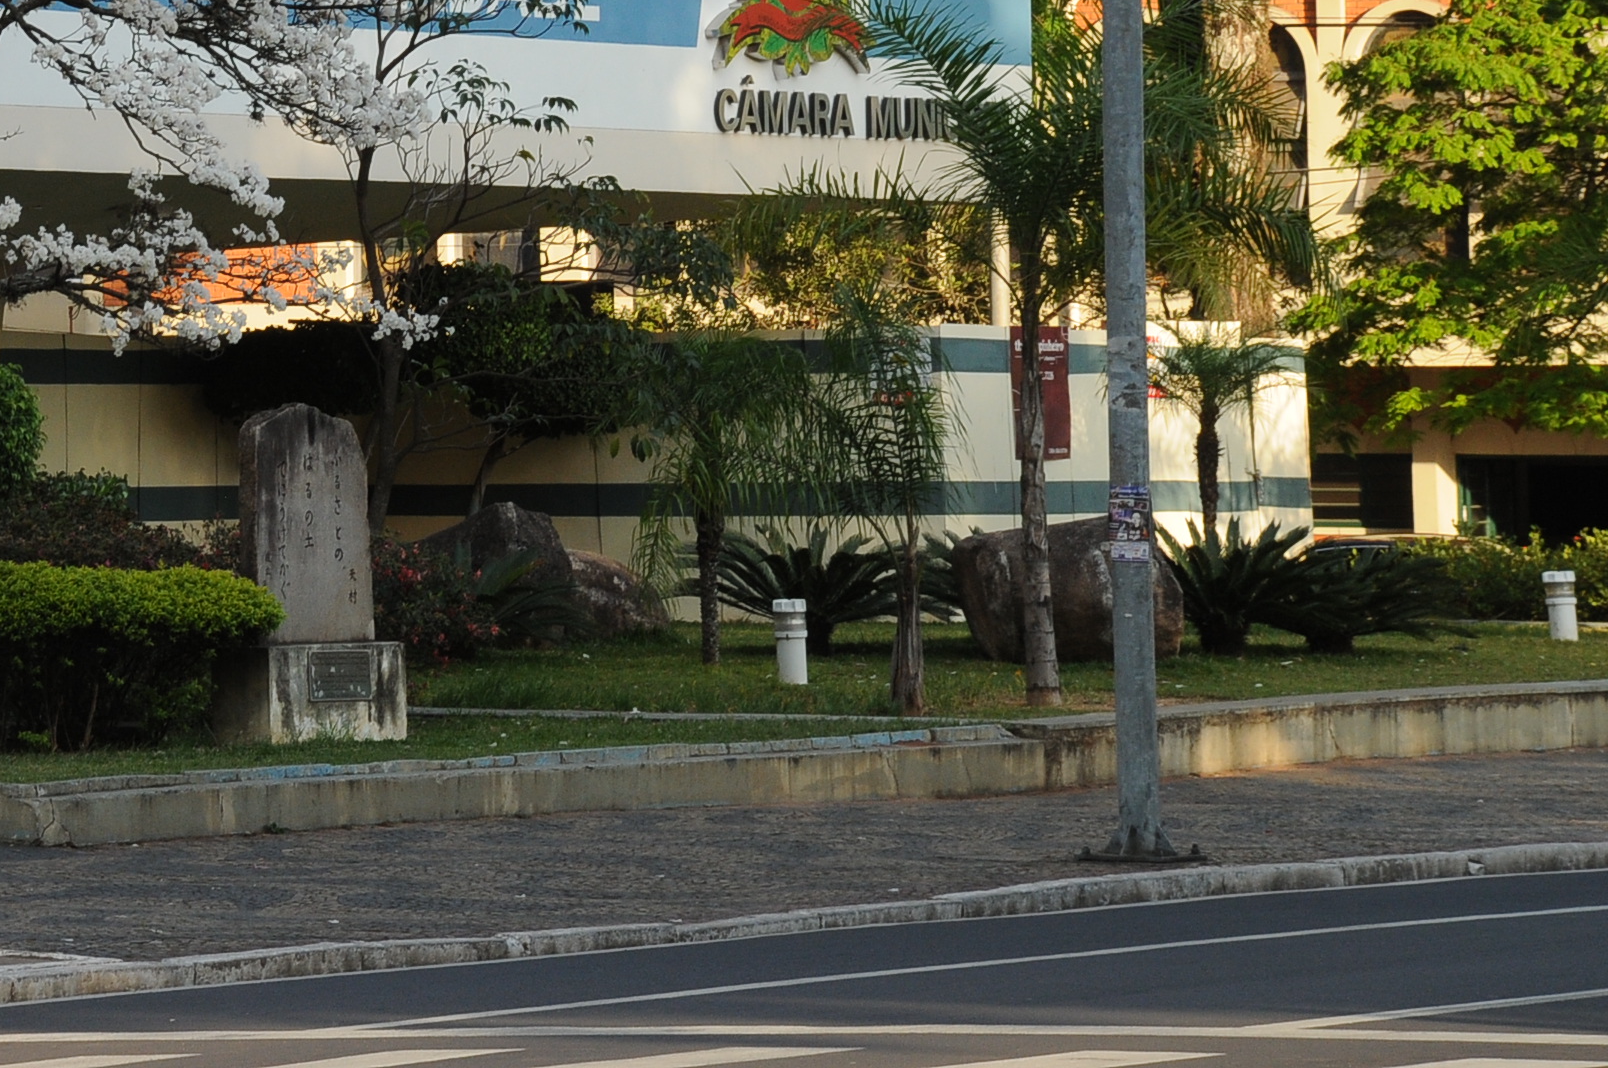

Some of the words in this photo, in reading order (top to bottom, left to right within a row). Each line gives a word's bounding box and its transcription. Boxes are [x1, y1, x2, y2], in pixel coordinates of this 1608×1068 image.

[713, 74, 856, 137] CÂMARA
[303, 453, 315, 550] はるの土
